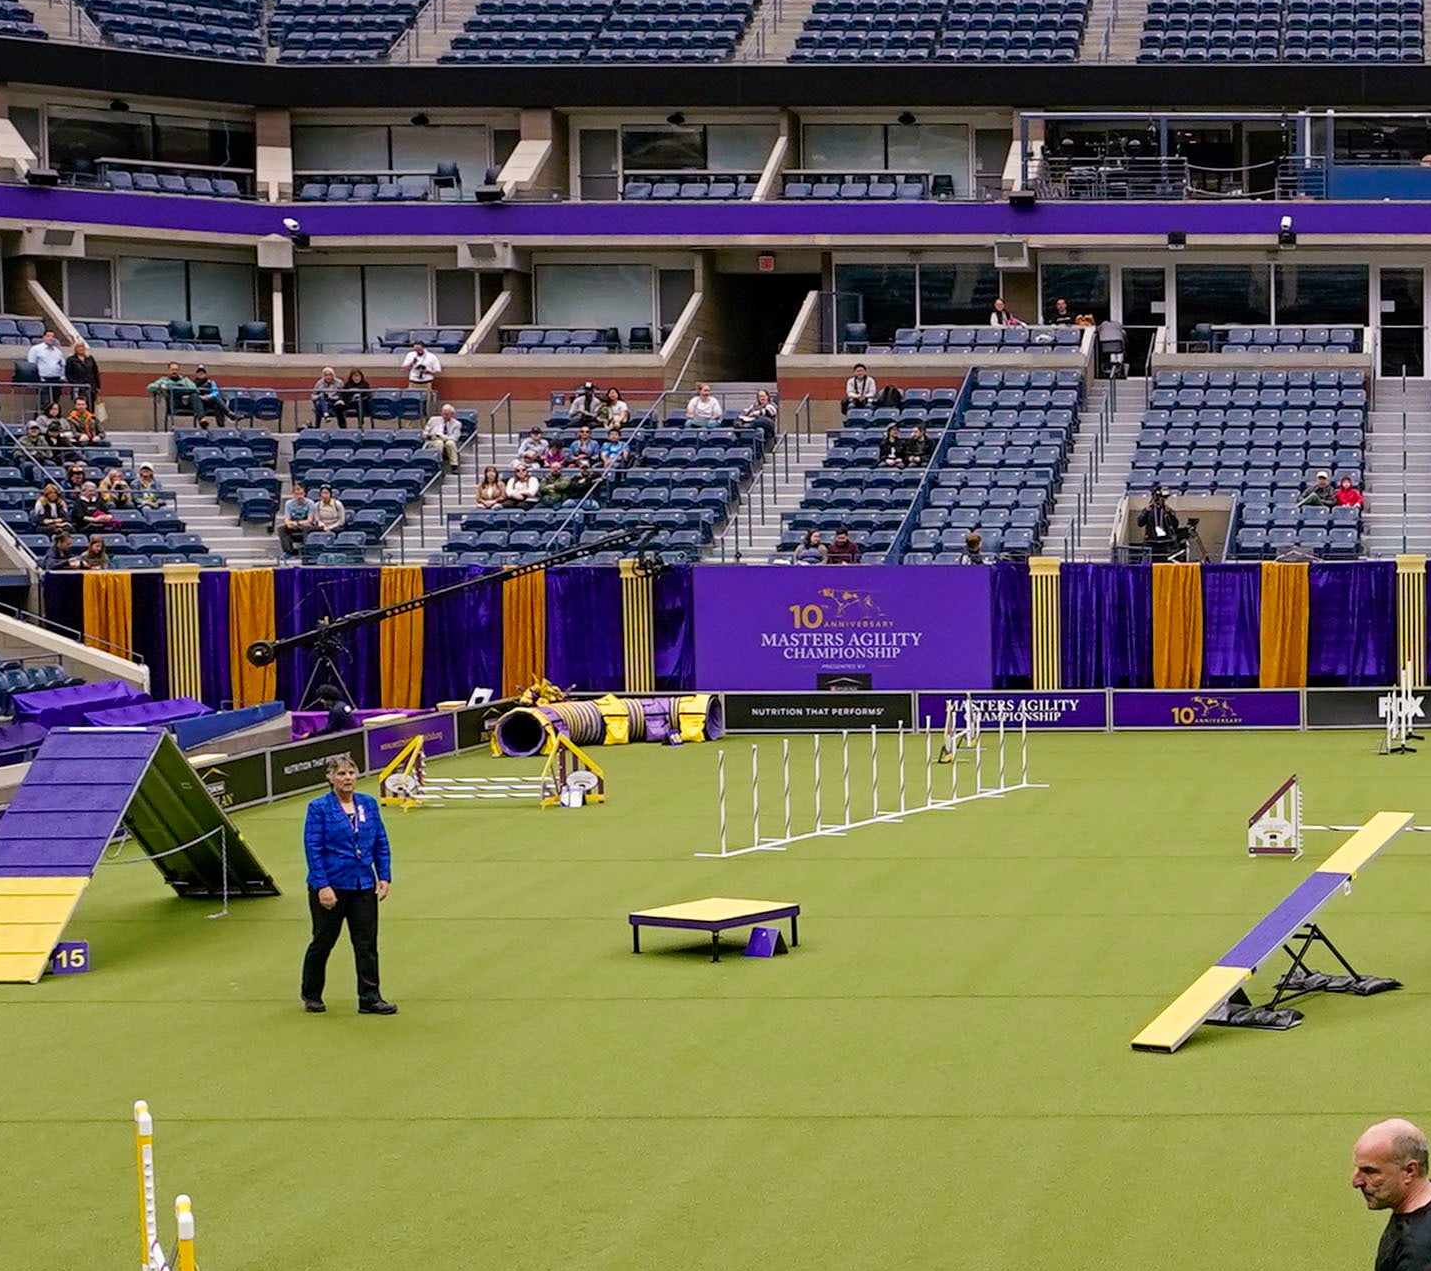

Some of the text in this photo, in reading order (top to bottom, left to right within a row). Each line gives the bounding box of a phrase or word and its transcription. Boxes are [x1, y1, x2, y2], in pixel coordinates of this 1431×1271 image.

[760, 632, 922, 647] MASTERS AGILITY
[783, 647, 901, 659] CHAMPIONSHIP
[752, 708, 803, 716] NUTRITION
[805, 708, 830, 716] THAT
[1017, 699, 1079, 713] AGILITY
[55, 948, 85, 969] 15
